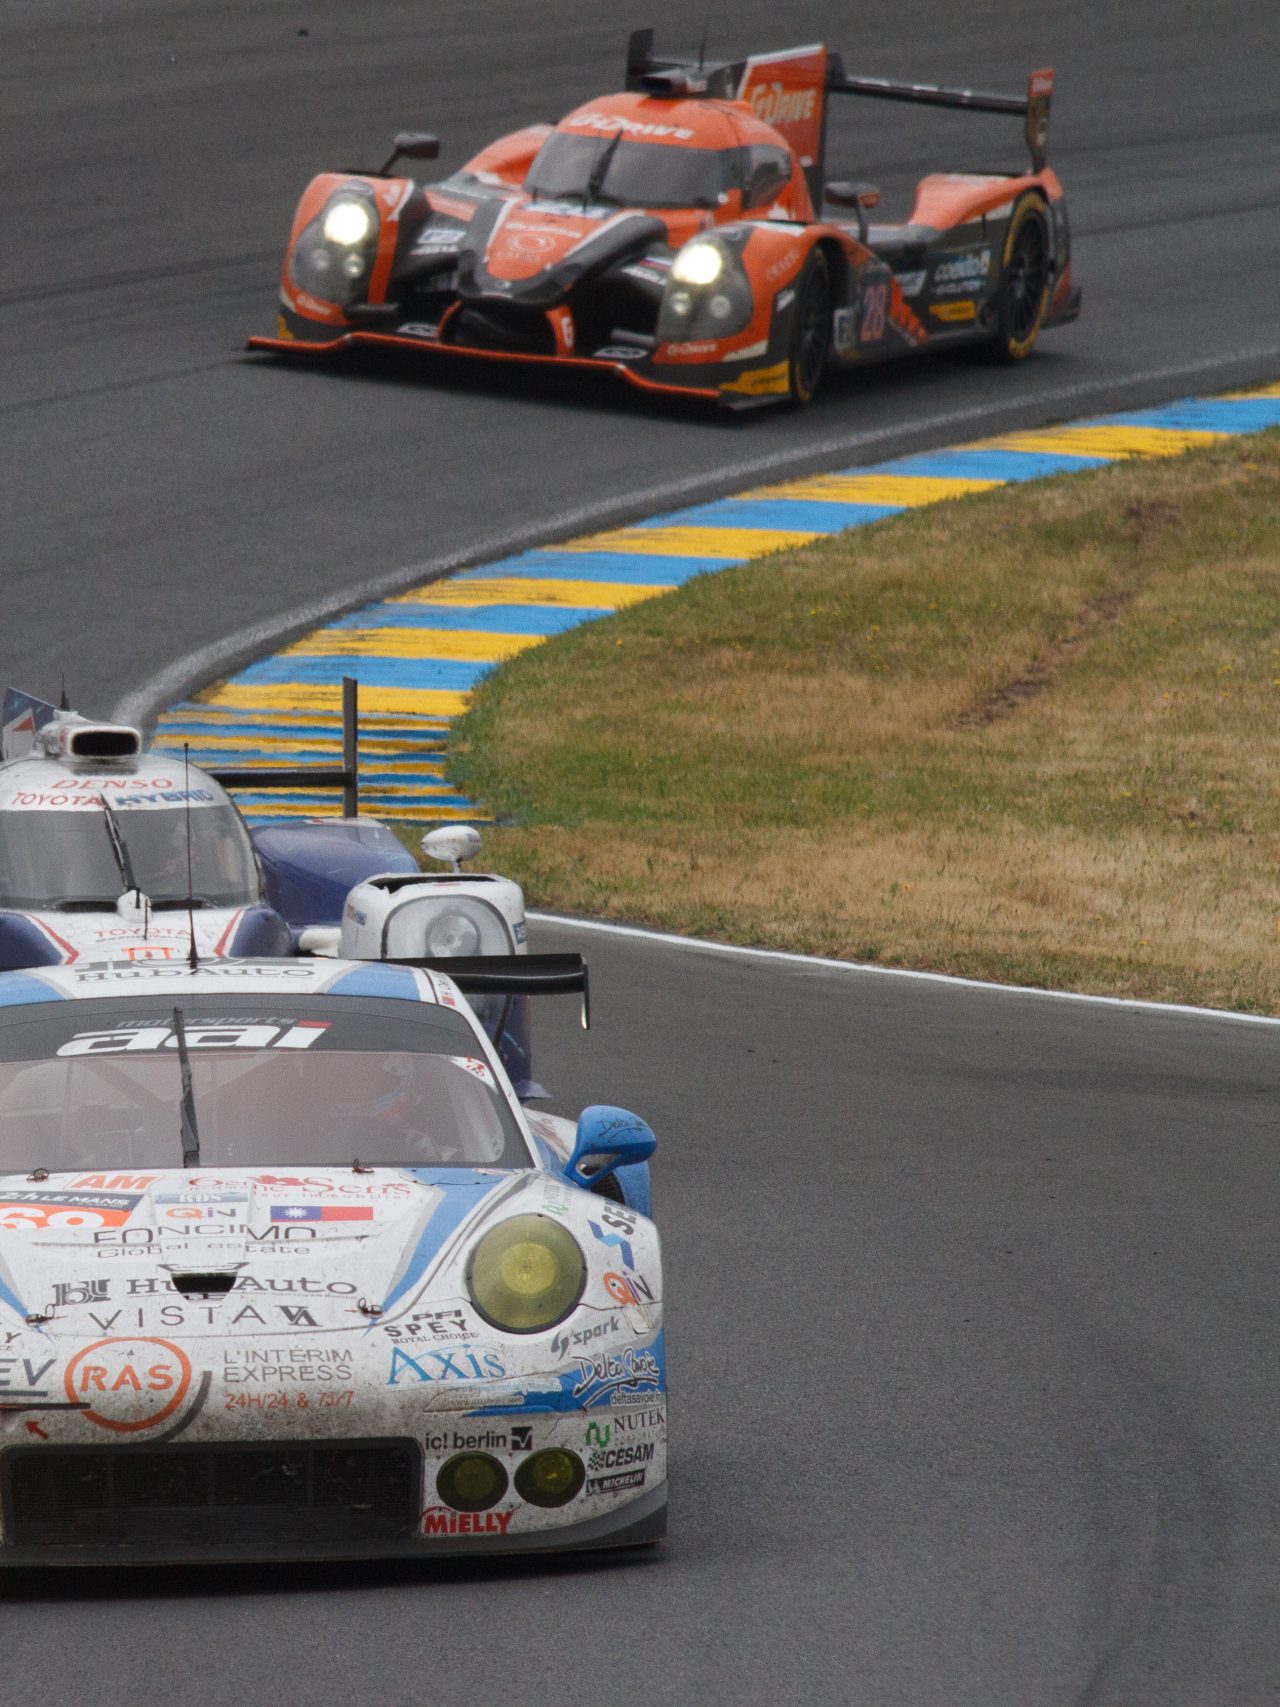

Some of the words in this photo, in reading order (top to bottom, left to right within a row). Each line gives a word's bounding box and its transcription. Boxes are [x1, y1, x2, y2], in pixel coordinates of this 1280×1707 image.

[51, 779, 173, 789] DENSO
[12, 792, 104, 805] TOYOTA
[114, 790, 214, 805] HYBRID
[57, 1020, 332, 1057] aai
[71, 1174, 158, 1190] AM
[40, 1195, 68, 1203] LE
[68, 1196, 131, 1206] MANS
[97, 1243, 188, 1258] Global
[208, 1242, 311, 1255] estate
[88, 1304, 268, 1332] VISTA
[411, 1309, 463, 1322] PFI
[383, 1319, 467, 1338] SPEY
[391, 1336, 431, 1345] ROYAL
[437, 1331, 480, 1342] CHOICE
[79, 1365, 175, 1392] RAS
[223, 1365, 352, 1383] EXPRESS
[223, 1391, 289, 1409] 24H/24
[296, 1393, 309, 1408] &
[614, 1407, 665, 1434] NUTEK
[453, 1431, 507, 1449] berlin
[604, 1443, 655, 1469] CESAM
[602, 1472, 644, 1490] MICHELIN
